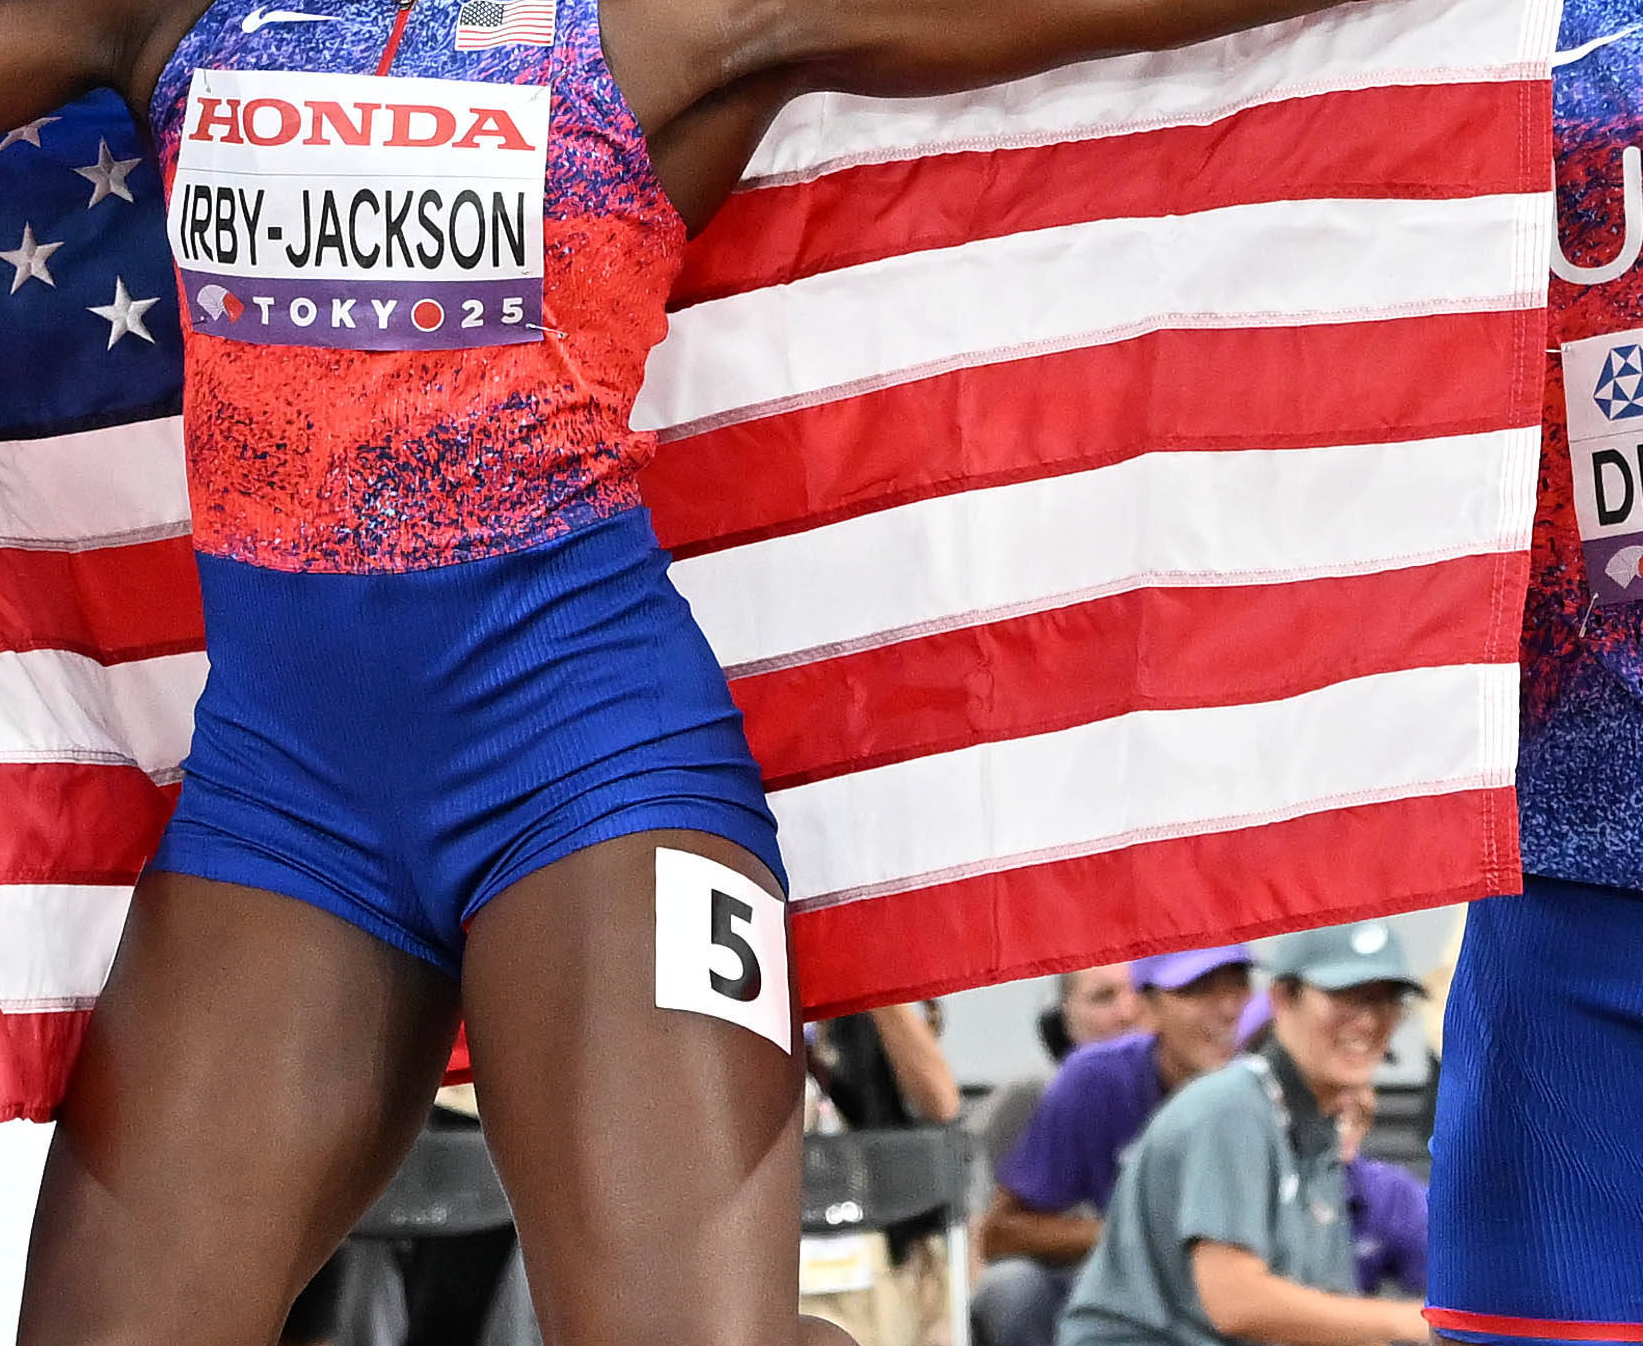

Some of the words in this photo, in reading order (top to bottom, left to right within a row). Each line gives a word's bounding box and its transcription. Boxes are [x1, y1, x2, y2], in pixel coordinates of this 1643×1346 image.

[188, 97, 536, 151] HONDA
[181, 184, 526, 269] IRBY-JACKSON
[709, 888, 762, 1002] 5
